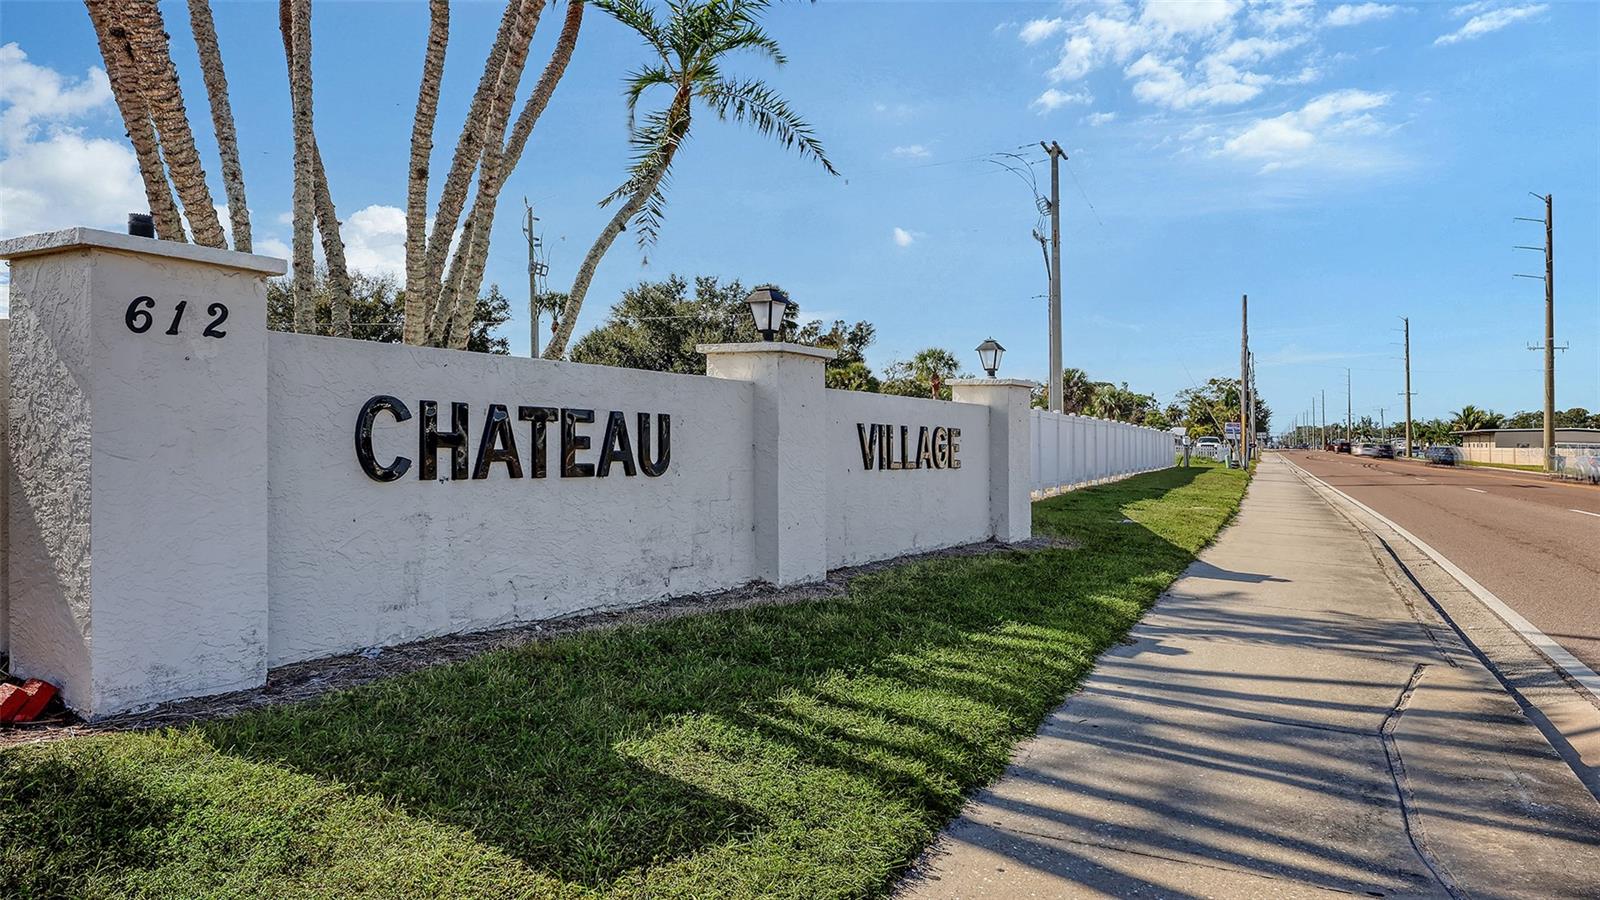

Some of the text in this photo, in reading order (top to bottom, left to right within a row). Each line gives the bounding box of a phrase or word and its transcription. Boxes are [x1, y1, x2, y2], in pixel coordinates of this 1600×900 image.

[125, 296, 228, 338] 612
[355, 395, 961, 482] CHATEAU VILLAGE
